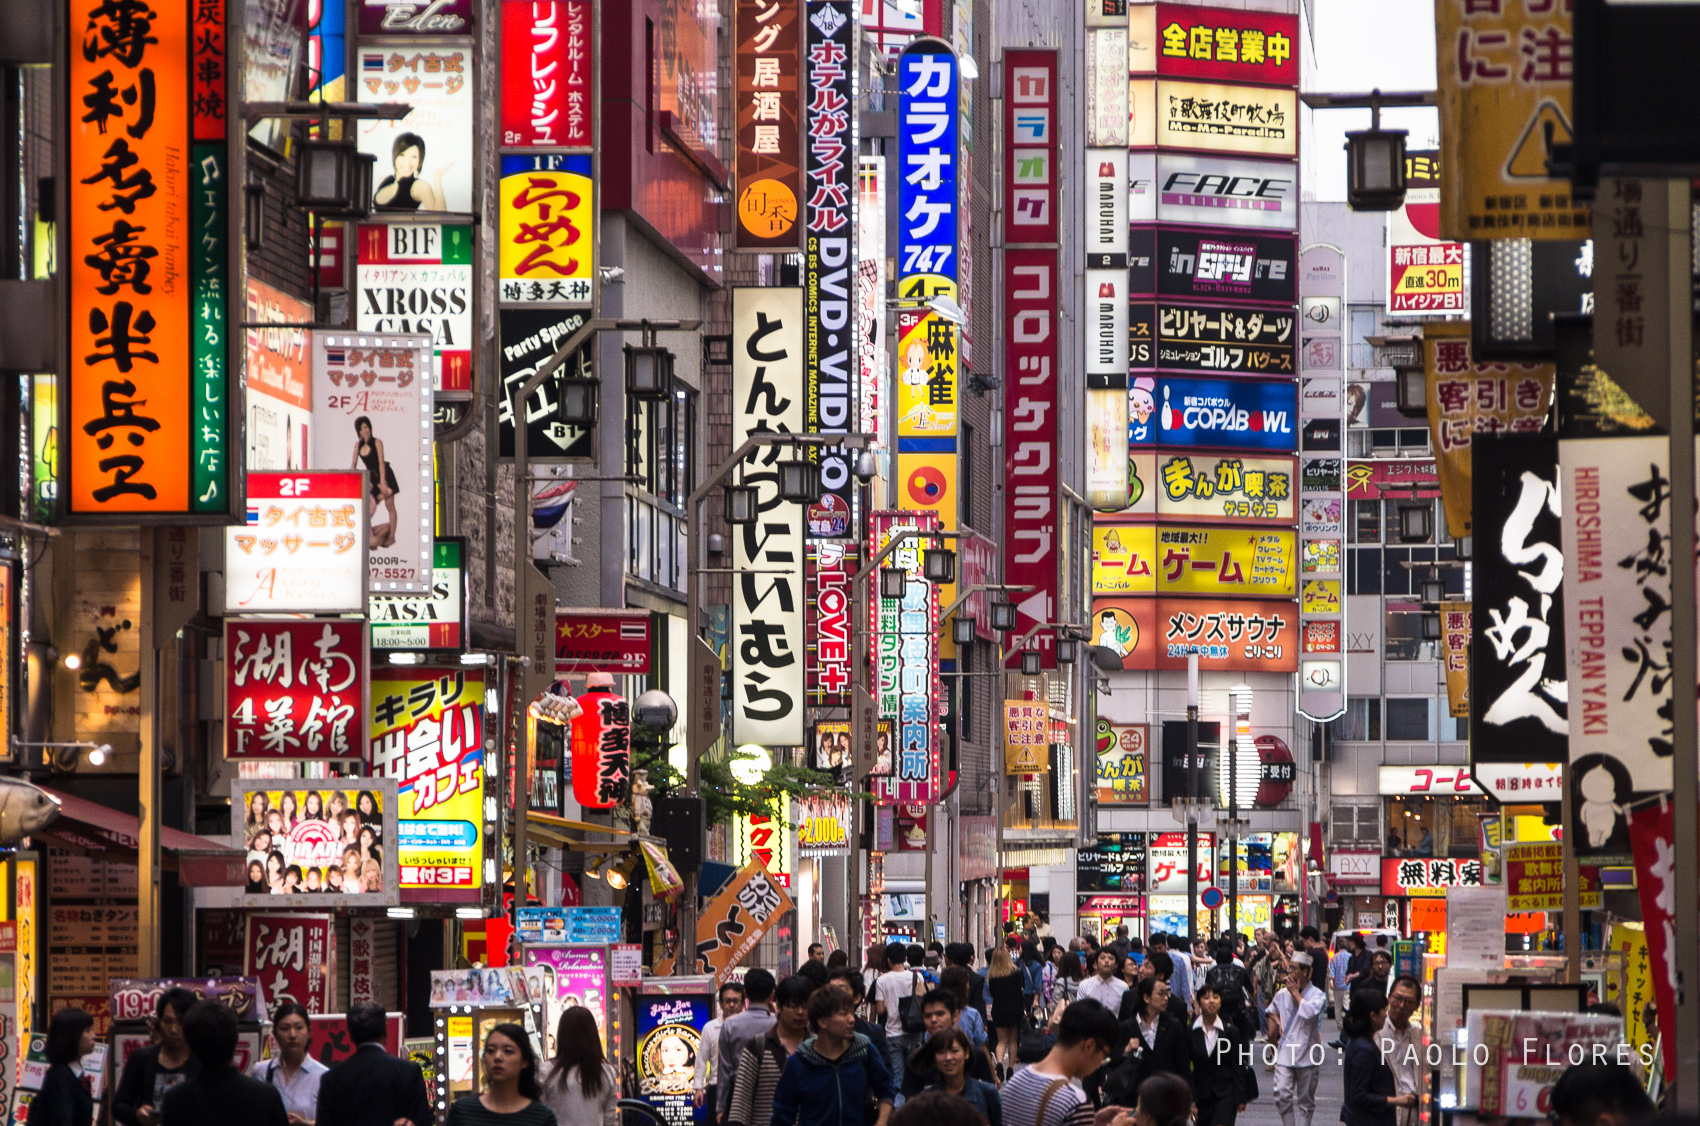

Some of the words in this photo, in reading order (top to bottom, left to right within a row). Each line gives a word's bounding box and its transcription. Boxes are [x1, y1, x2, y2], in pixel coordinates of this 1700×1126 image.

[381, 0, 466, 30] Eden
[568, 1, 583, 85] レンタルルーム
[1162, 22, 1291, 66] 全店営業中
[387, 52, 464, 73] タイ古式
[531, 1, 558, 145] リフレッシュ
[363, 75, 464, 95] マッサージ
[568, 91, 583, 139] ホステル
[504, 130, 522, 144] 2F
[808, 39, 849, 232] ホテルがライバル
[905, 54, 951, 240] カラオケ
[1162, 172, 1292, 199] FACE
[1099, 182, 1114, 244] MARUHAN
[392, 228, 437, 255] B1F
[902, 245, 952, 273] 747
[1394, 246, 1462, 265] 新宿最大
[363, 288, 467, 315] XROSS
[503, 280, 591, 301] 博多天神
[808, 271, 818, 313] COMICS
[1394, 292, 1463, 310] ハイジアB1
[899, 314, 919, 326] 3F
[1099, 302, 1114, 364] MARUHAN
[504, 327, 542, 362] Party
[538, 313, 584, 353] Space
[808, 315, 818, 367] INTERNET
[347, 351, 414, 369] タイ古式
[927, 317, 954, 406] 麻雀
[1200, 345, 1244, 370] ゴルフ
[1247, 352, 1293, 370] バグース
[327, 370, 414, 388] マッサージ
[328, 395, 351, 409] 2F
[808, 369, 818, 424] MAGAZINE
[1438, 378, 1543, 414] 客引き
[553, 425, 579, 438] B1
[1306, 468, 1340, 477] ビリヤード
[1319, 459, 1340, 467] ダーツ
[279, 479, 311, 496] 2F
[1163, 457, 1290, 500] まんが喫茶
[264, 504, 356, 529] タイ古式
[1224, 500, 1279, 519] ゲラゲラ
[1305, 524, 1339, 532] ボウリング
[1574, 466, 1603, 585] HIROSHIMA
[234, 532, 356, 556] マッサージ
[1162, 547, 1245, 586] ゲーム
[1304, 592, 1339, 604] ゲーム
[1166, 611, 1286, 643] メンズサウナ
[234, 623, 357, 695] 湖南
[622, 652, 647, 668] 2F
[374, 671, 465, 727] キラリ
[1008, 706, 1045, 719] 悪質な
[259, 696, 357, 756] 菜館
[1008, 719, 1045, 732] 客引き
[1008, 733, 1046, 745] に注意
[1121, 732, 1140, 744] 24
[372, 706, 478, 782] 出会い
[599, 700, 631, 804] 博多天神
[413, 760, 480, 815] カフェ
